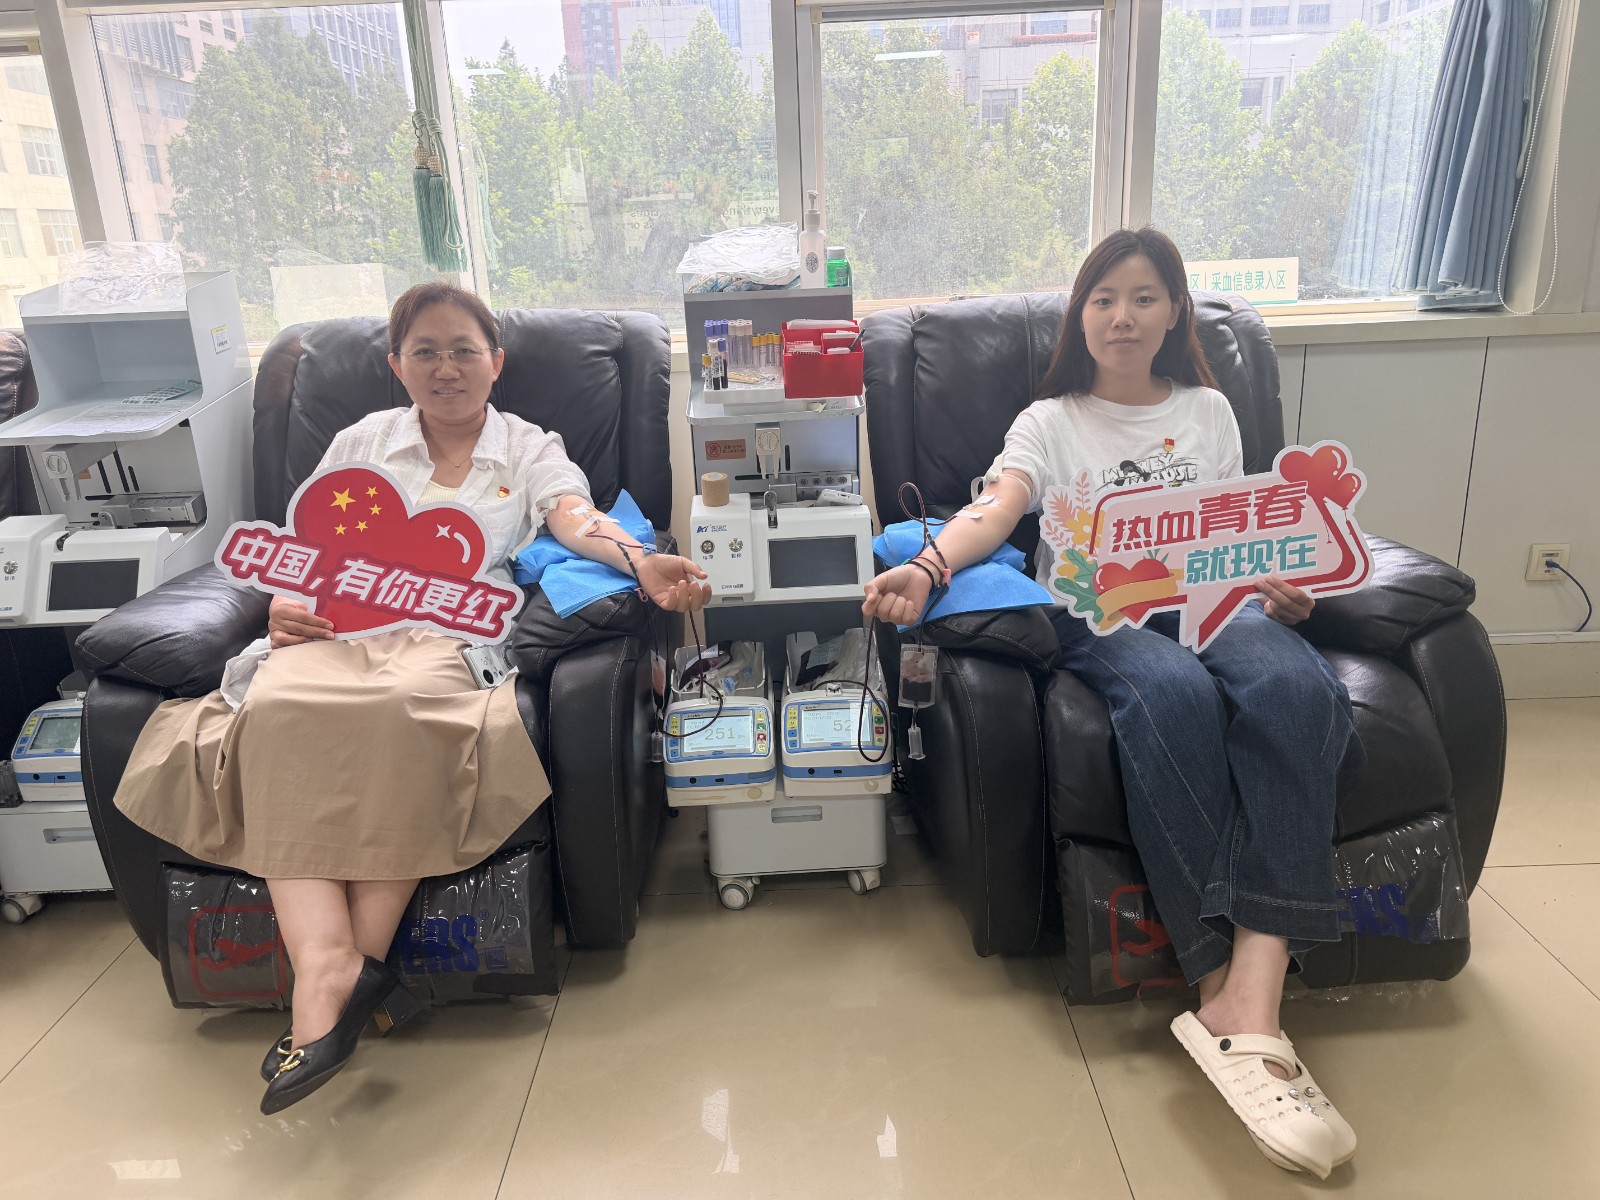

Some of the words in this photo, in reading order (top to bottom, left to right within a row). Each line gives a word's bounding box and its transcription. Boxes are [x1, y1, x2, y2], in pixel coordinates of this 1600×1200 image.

[1211, 269, 1287, 292] 采血信息录入区
[1111, 481, 1309, 553] 热血青春
[1186, 533, 1318, 585] 就现在
[704, 727, 735, 741] 251
